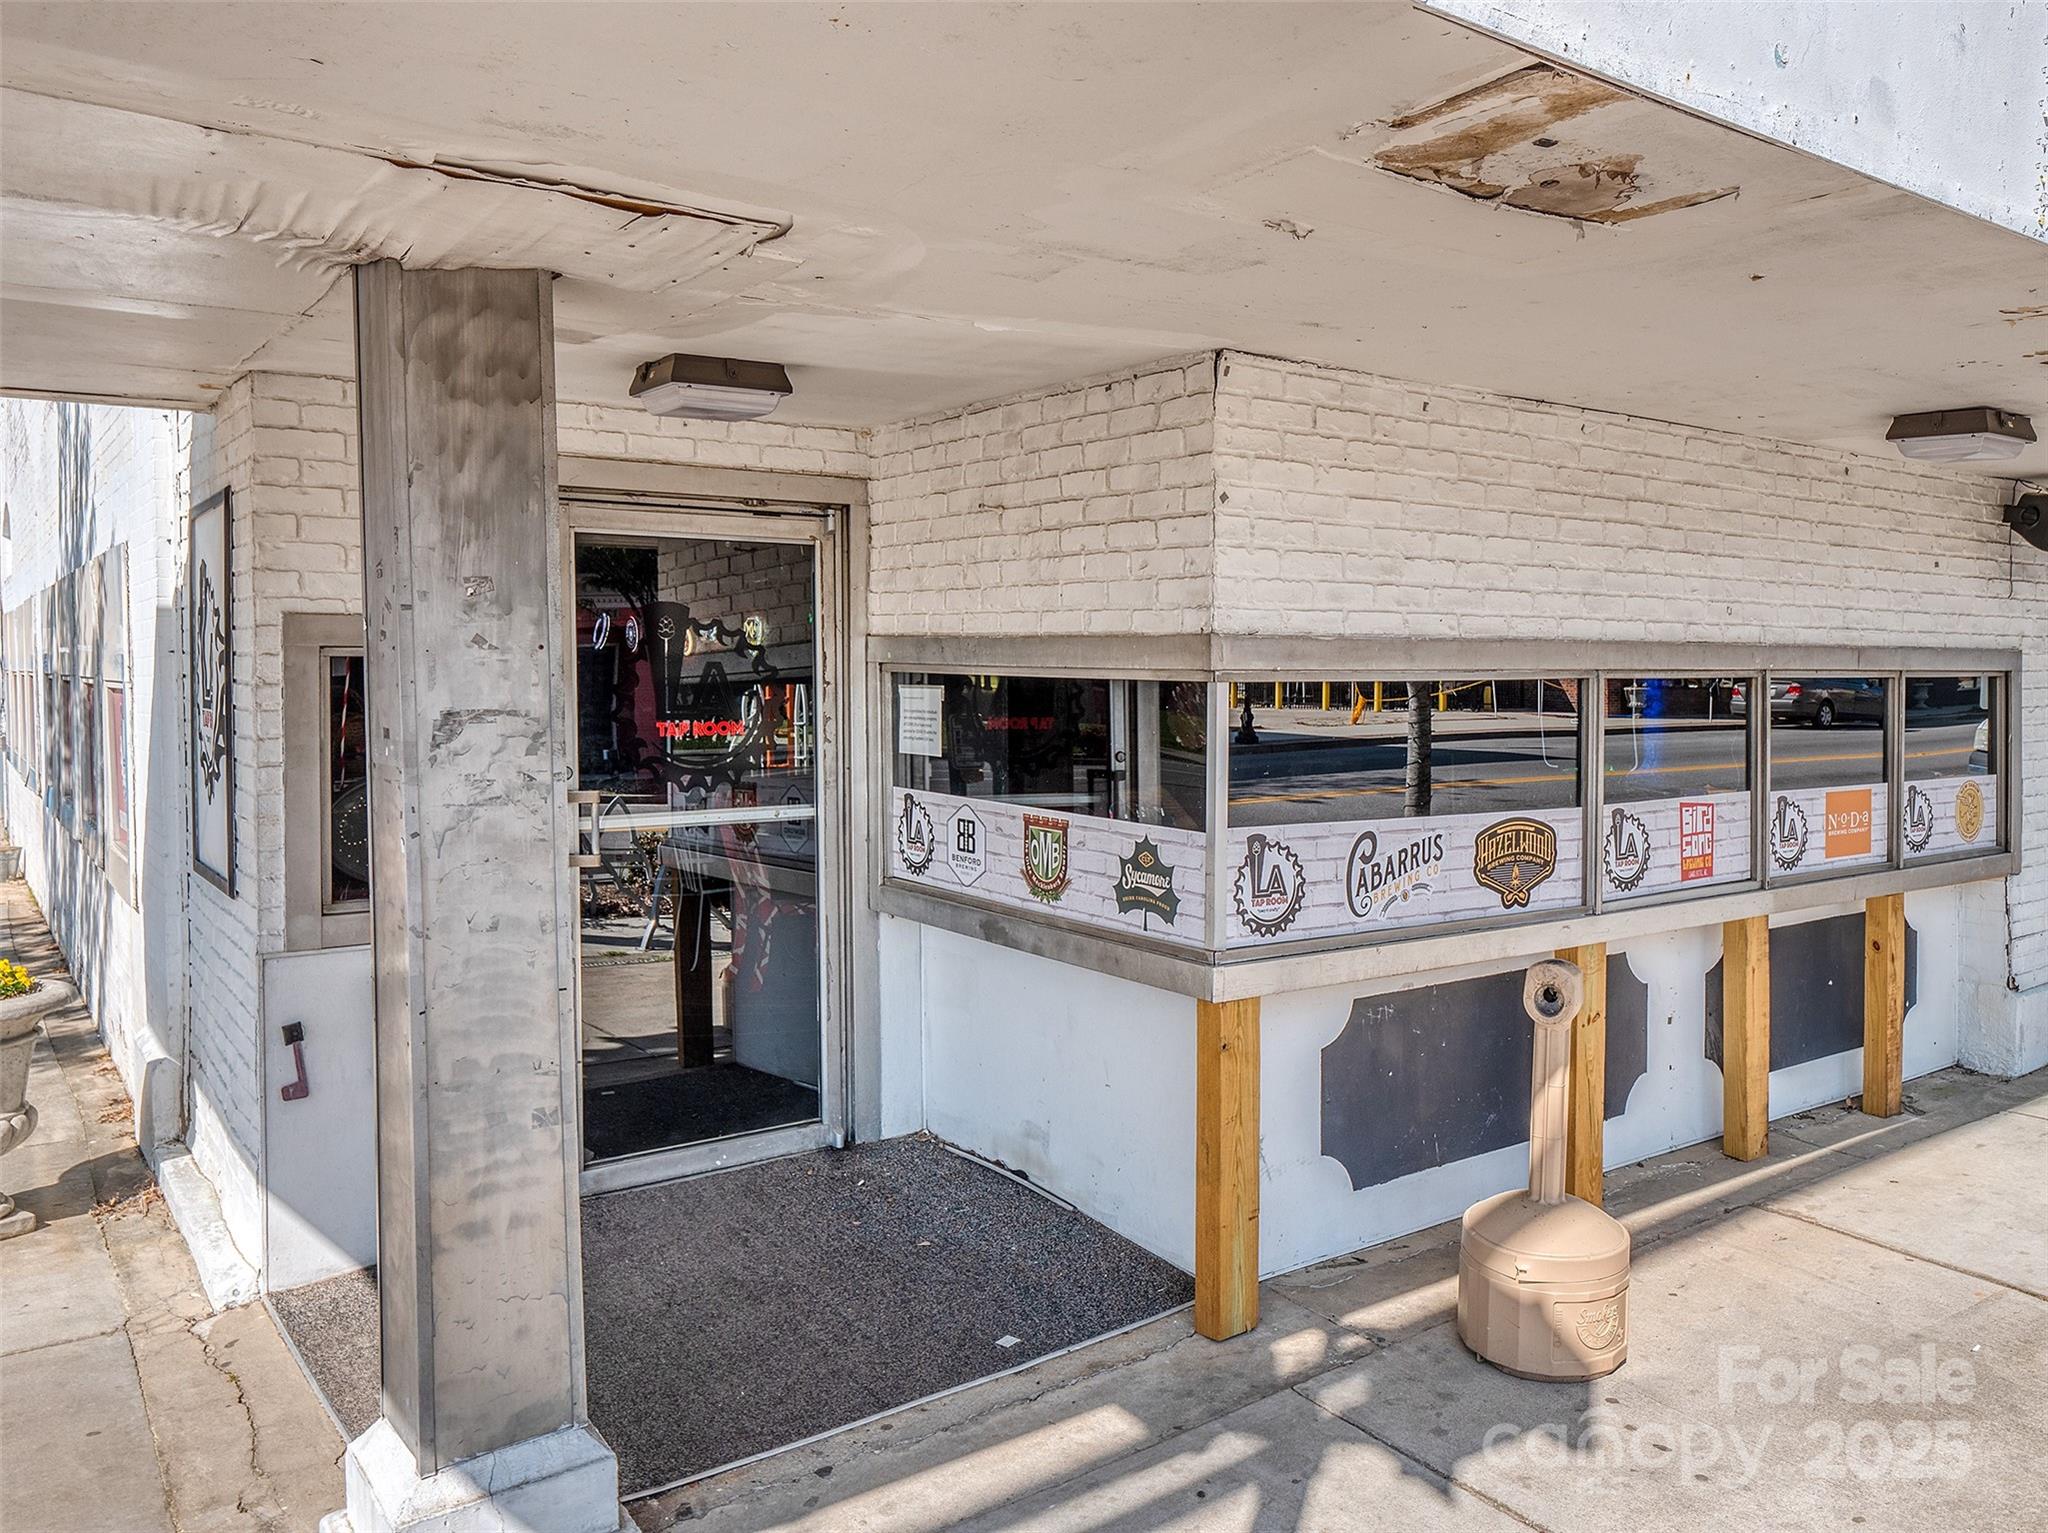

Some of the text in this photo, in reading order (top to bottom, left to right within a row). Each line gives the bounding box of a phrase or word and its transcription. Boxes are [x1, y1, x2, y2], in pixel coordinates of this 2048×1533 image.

[656, 721, 746, 737] TAP ROOM
[952, 853, 982, 867] BENFORD
[1031, 832, 1060, 878] OMB
[1480, 831, 1552, 868] HAZELWOOD
[1122, 863, 1171, 889] Sycamore
[1346, 831, 1444, 918] CABARRUS
[1486, 855, 1544, 871] BREWING COMPANY
[1373, 864, 1439, 904] BREWING CO
[1251, 897, 1288, 907] TAP ROOM
